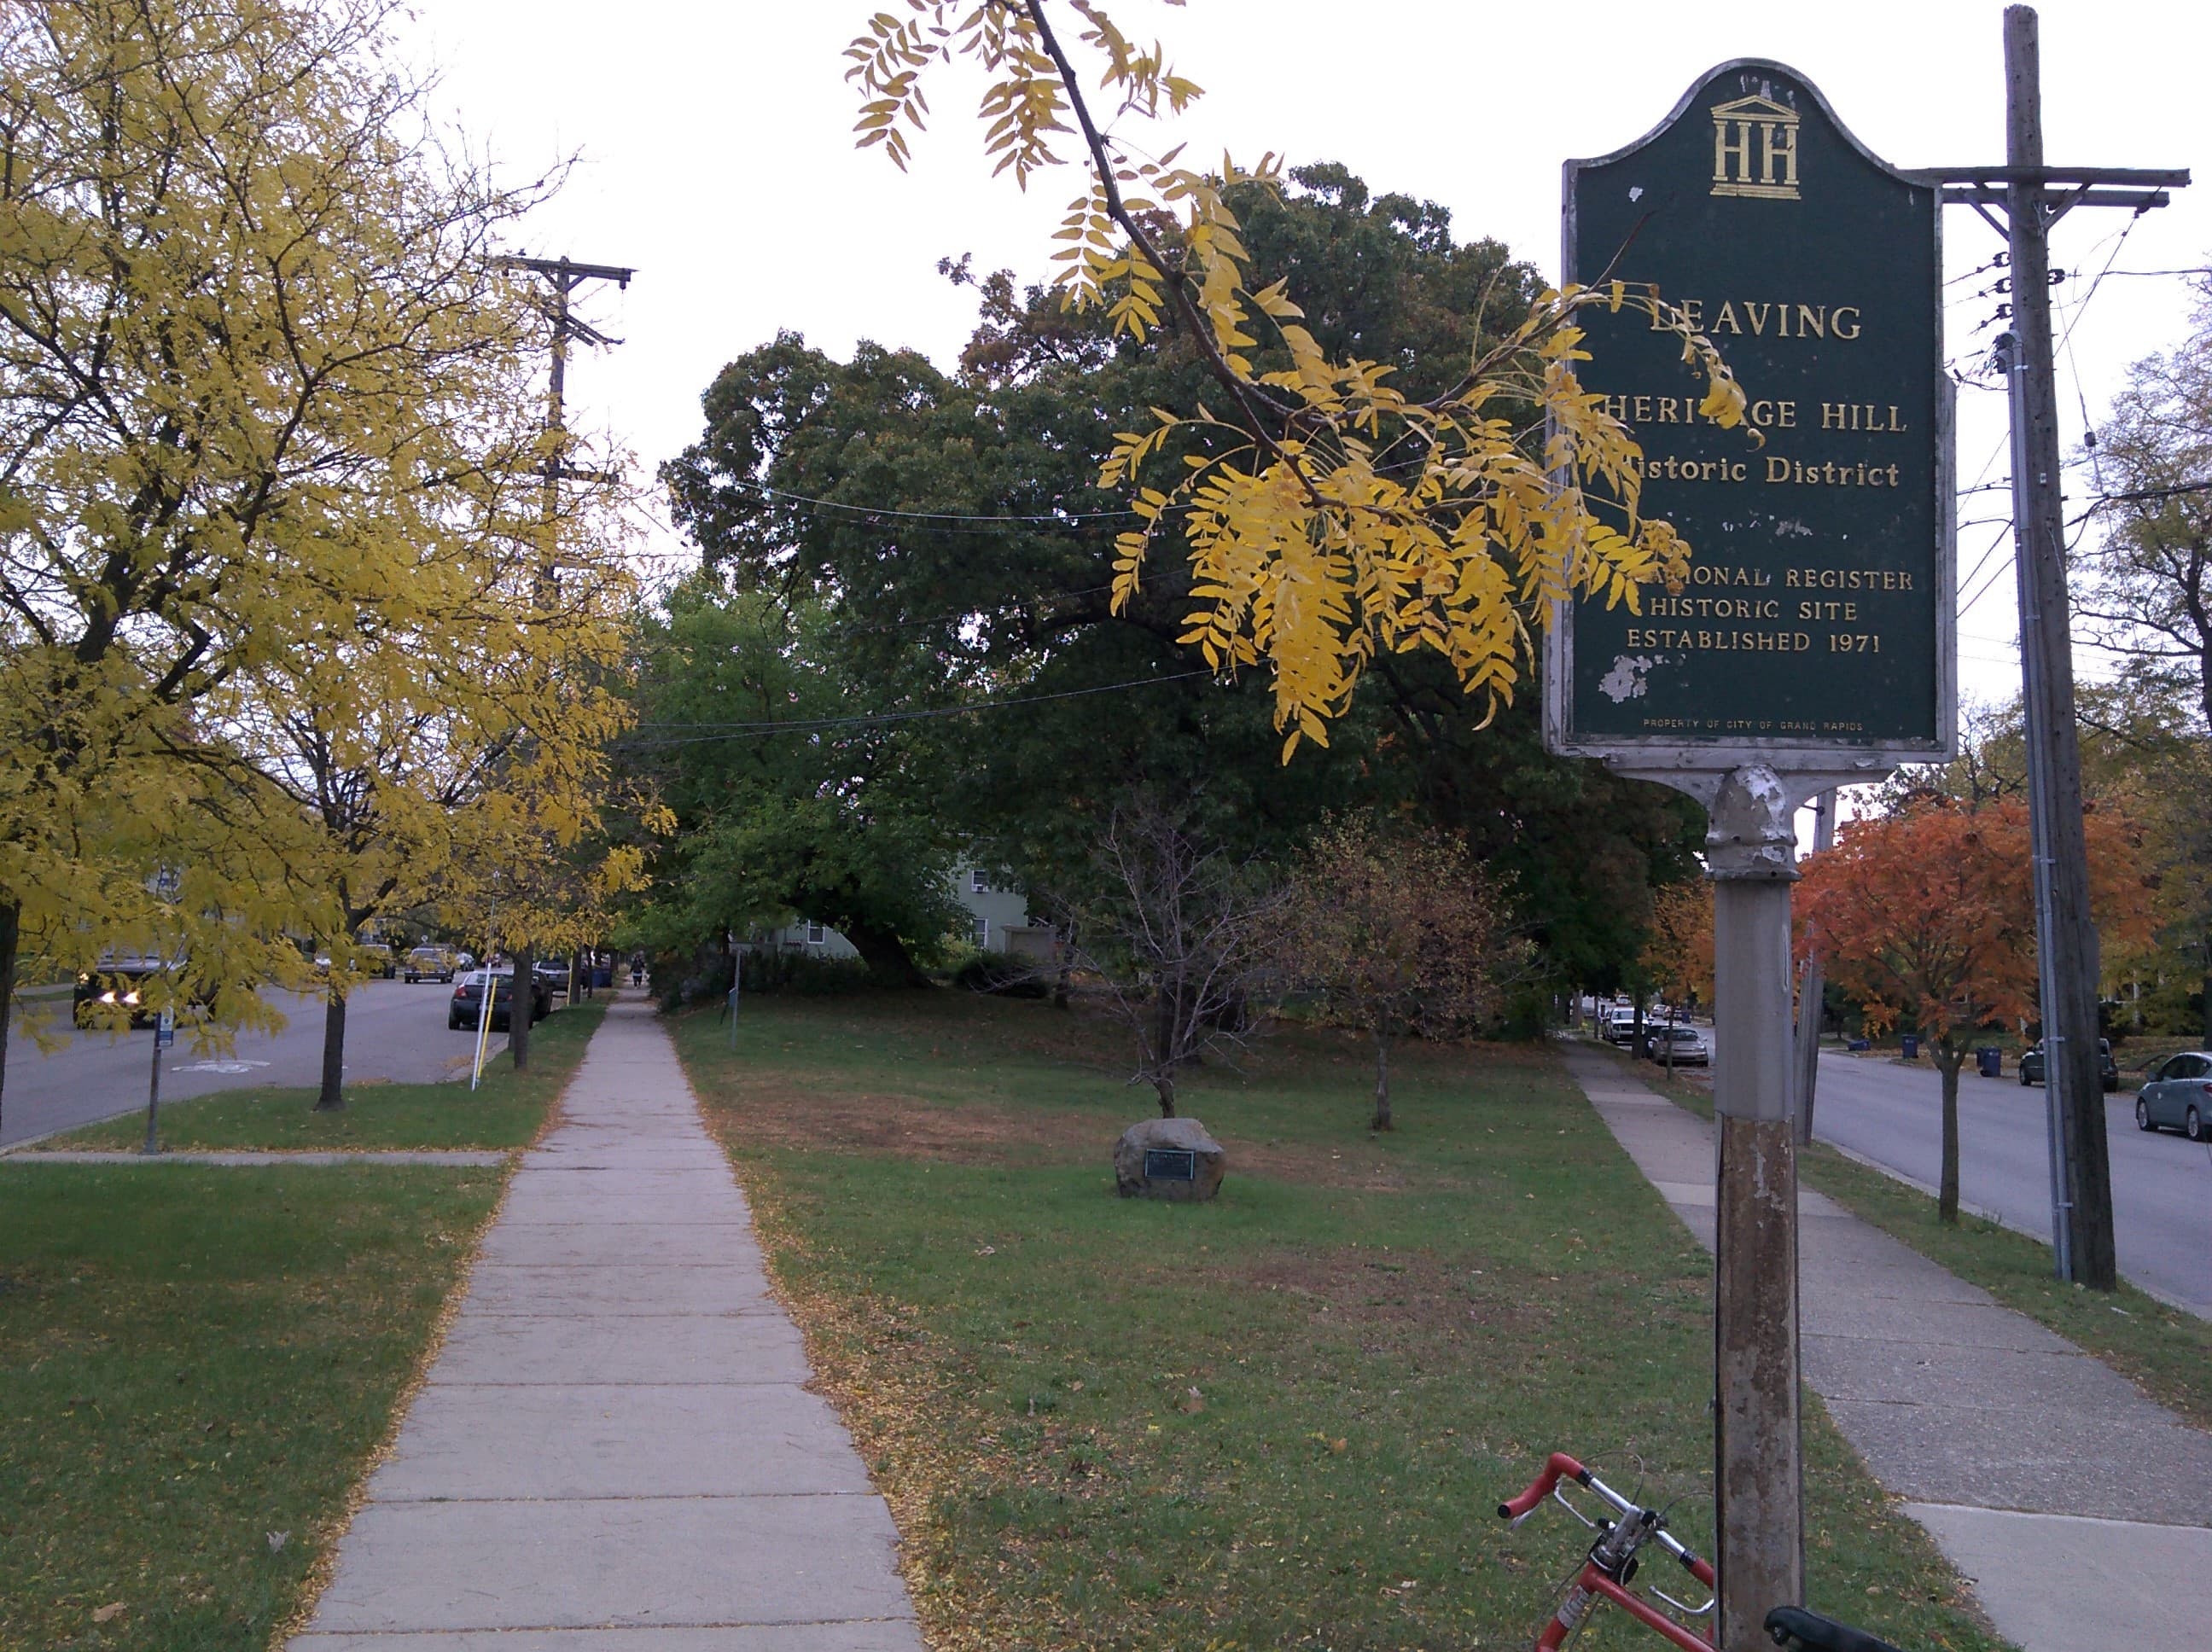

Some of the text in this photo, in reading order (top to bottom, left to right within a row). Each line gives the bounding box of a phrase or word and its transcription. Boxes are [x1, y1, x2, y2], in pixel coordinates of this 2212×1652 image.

[1650, 300, 1861, 340] LEAVING
[1604, 394, 1906, 433] HERIGE HILL
[1624, 455, 1899, 487] istoric District
[1785, 569, 1913, 590] REGISTER
[1650, 597, 1858, 621] HISTORIC SITE
[1627, 629, 1880, 654] ESTABLISHED 1971
[1643, 718, 1864, 731] PROPERTY OF CITY OF GRAND RAPIDS
